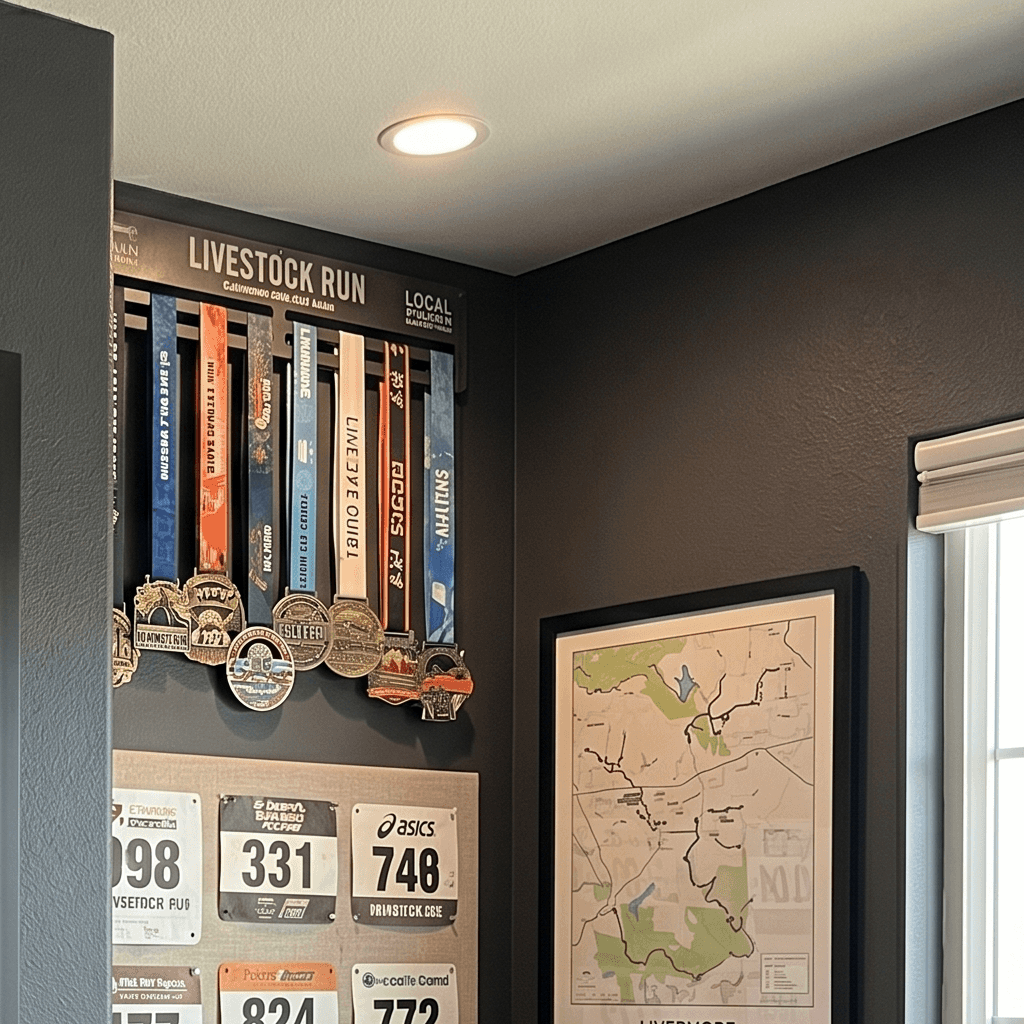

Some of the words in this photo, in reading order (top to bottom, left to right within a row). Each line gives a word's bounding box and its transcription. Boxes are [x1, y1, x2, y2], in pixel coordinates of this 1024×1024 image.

[189, 236, 314, 293] LIVESTOCK
[321, 265, 366, 304] RUN
[405, 289, 453, 316] LOCAL
[241, 838, 311, 888] 331
[372, 845, 440, 893] 748
